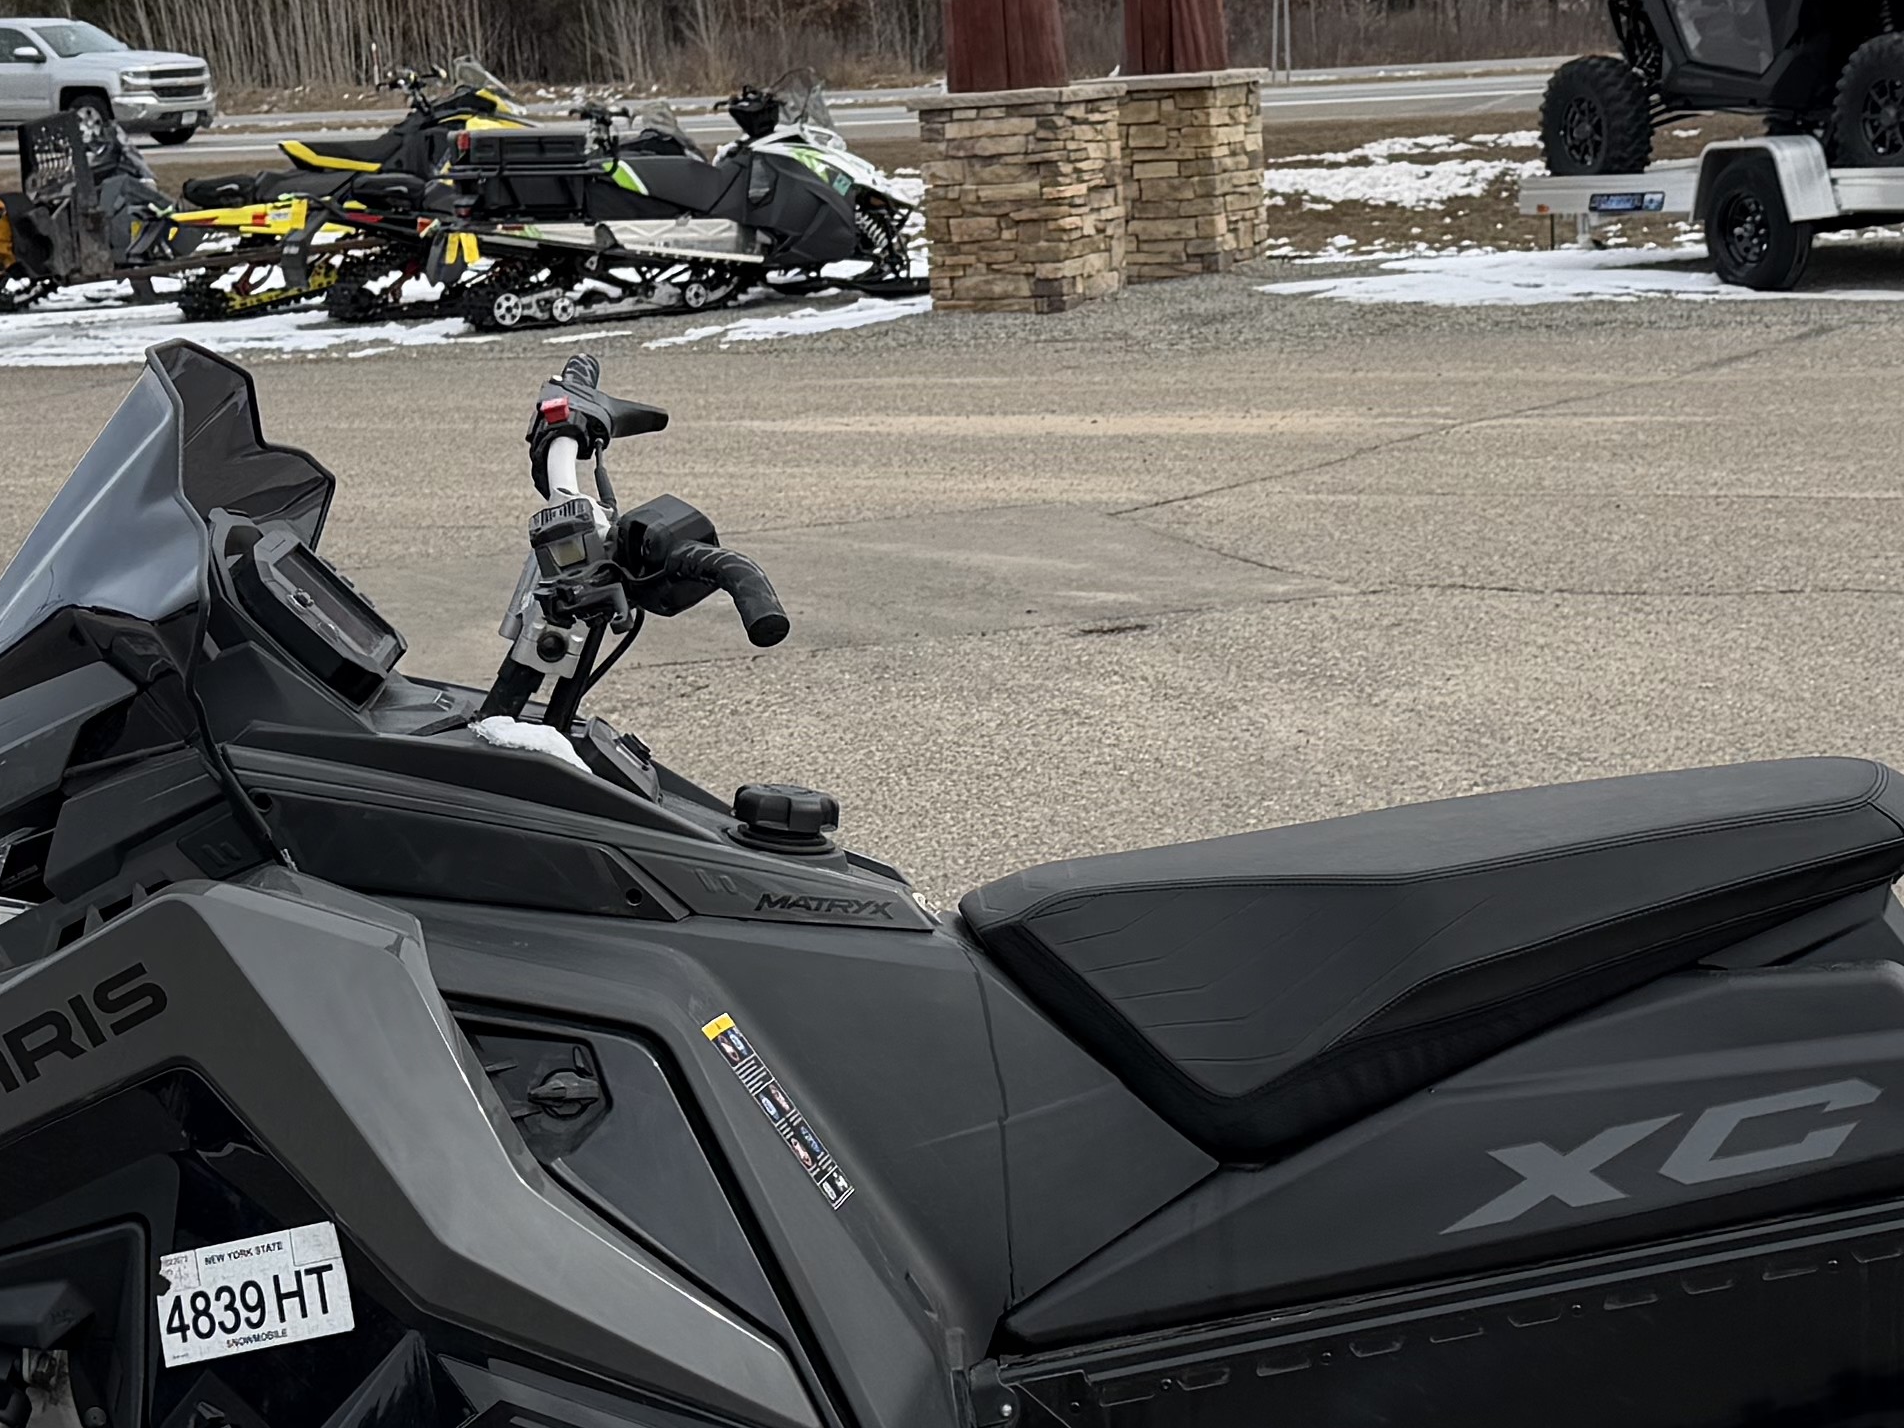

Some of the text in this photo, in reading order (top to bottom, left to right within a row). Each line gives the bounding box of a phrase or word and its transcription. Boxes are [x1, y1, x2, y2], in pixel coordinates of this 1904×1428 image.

[754, 892, 895, 920] MATRYX
[1438, 1077, 1885, 1236] XC
[204, 1240, 284, 1267] NEW YORK STATE
[165, 1263, 334, 1344] 4839 HT
[226, 1328, 288, 1349] SNOWMOBILE
